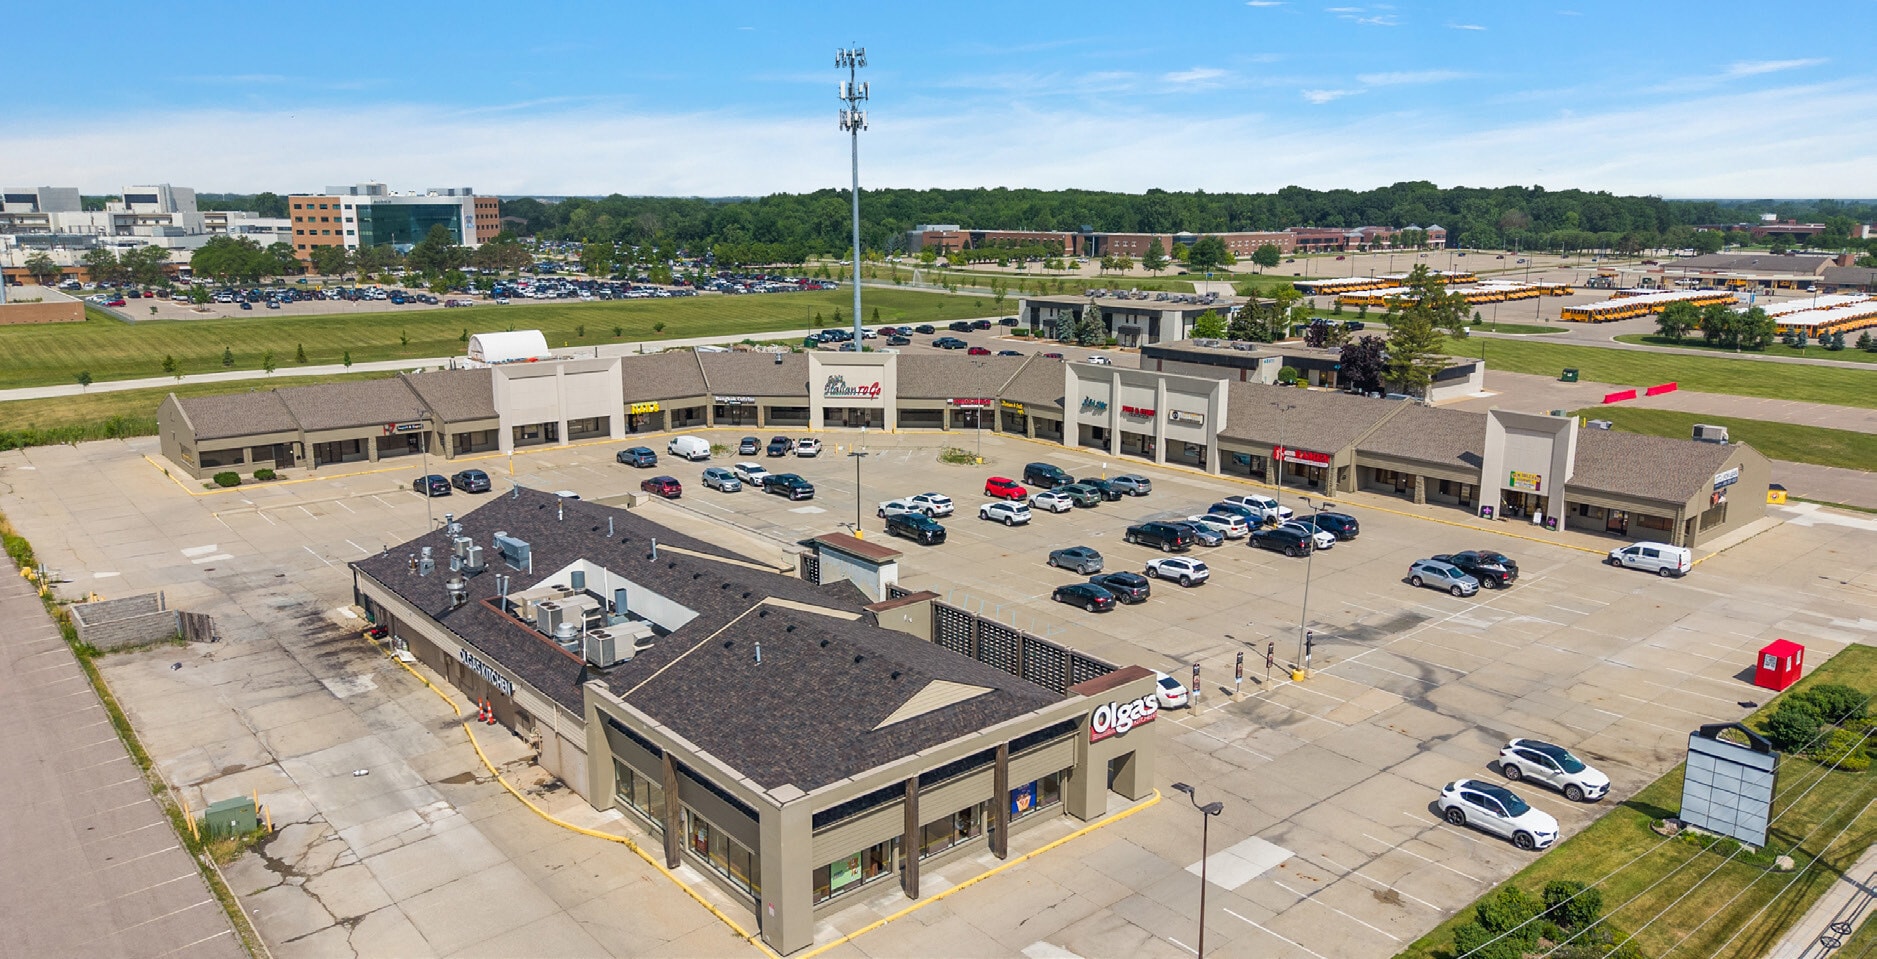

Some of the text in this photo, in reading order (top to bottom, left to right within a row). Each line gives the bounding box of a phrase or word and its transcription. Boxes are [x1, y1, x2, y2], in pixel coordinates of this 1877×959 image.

[631, 402, 660, 415] NAILS
[480, 663, 512, 697] KITCHEN
[1093, 694, 1159, 733] Olga's
